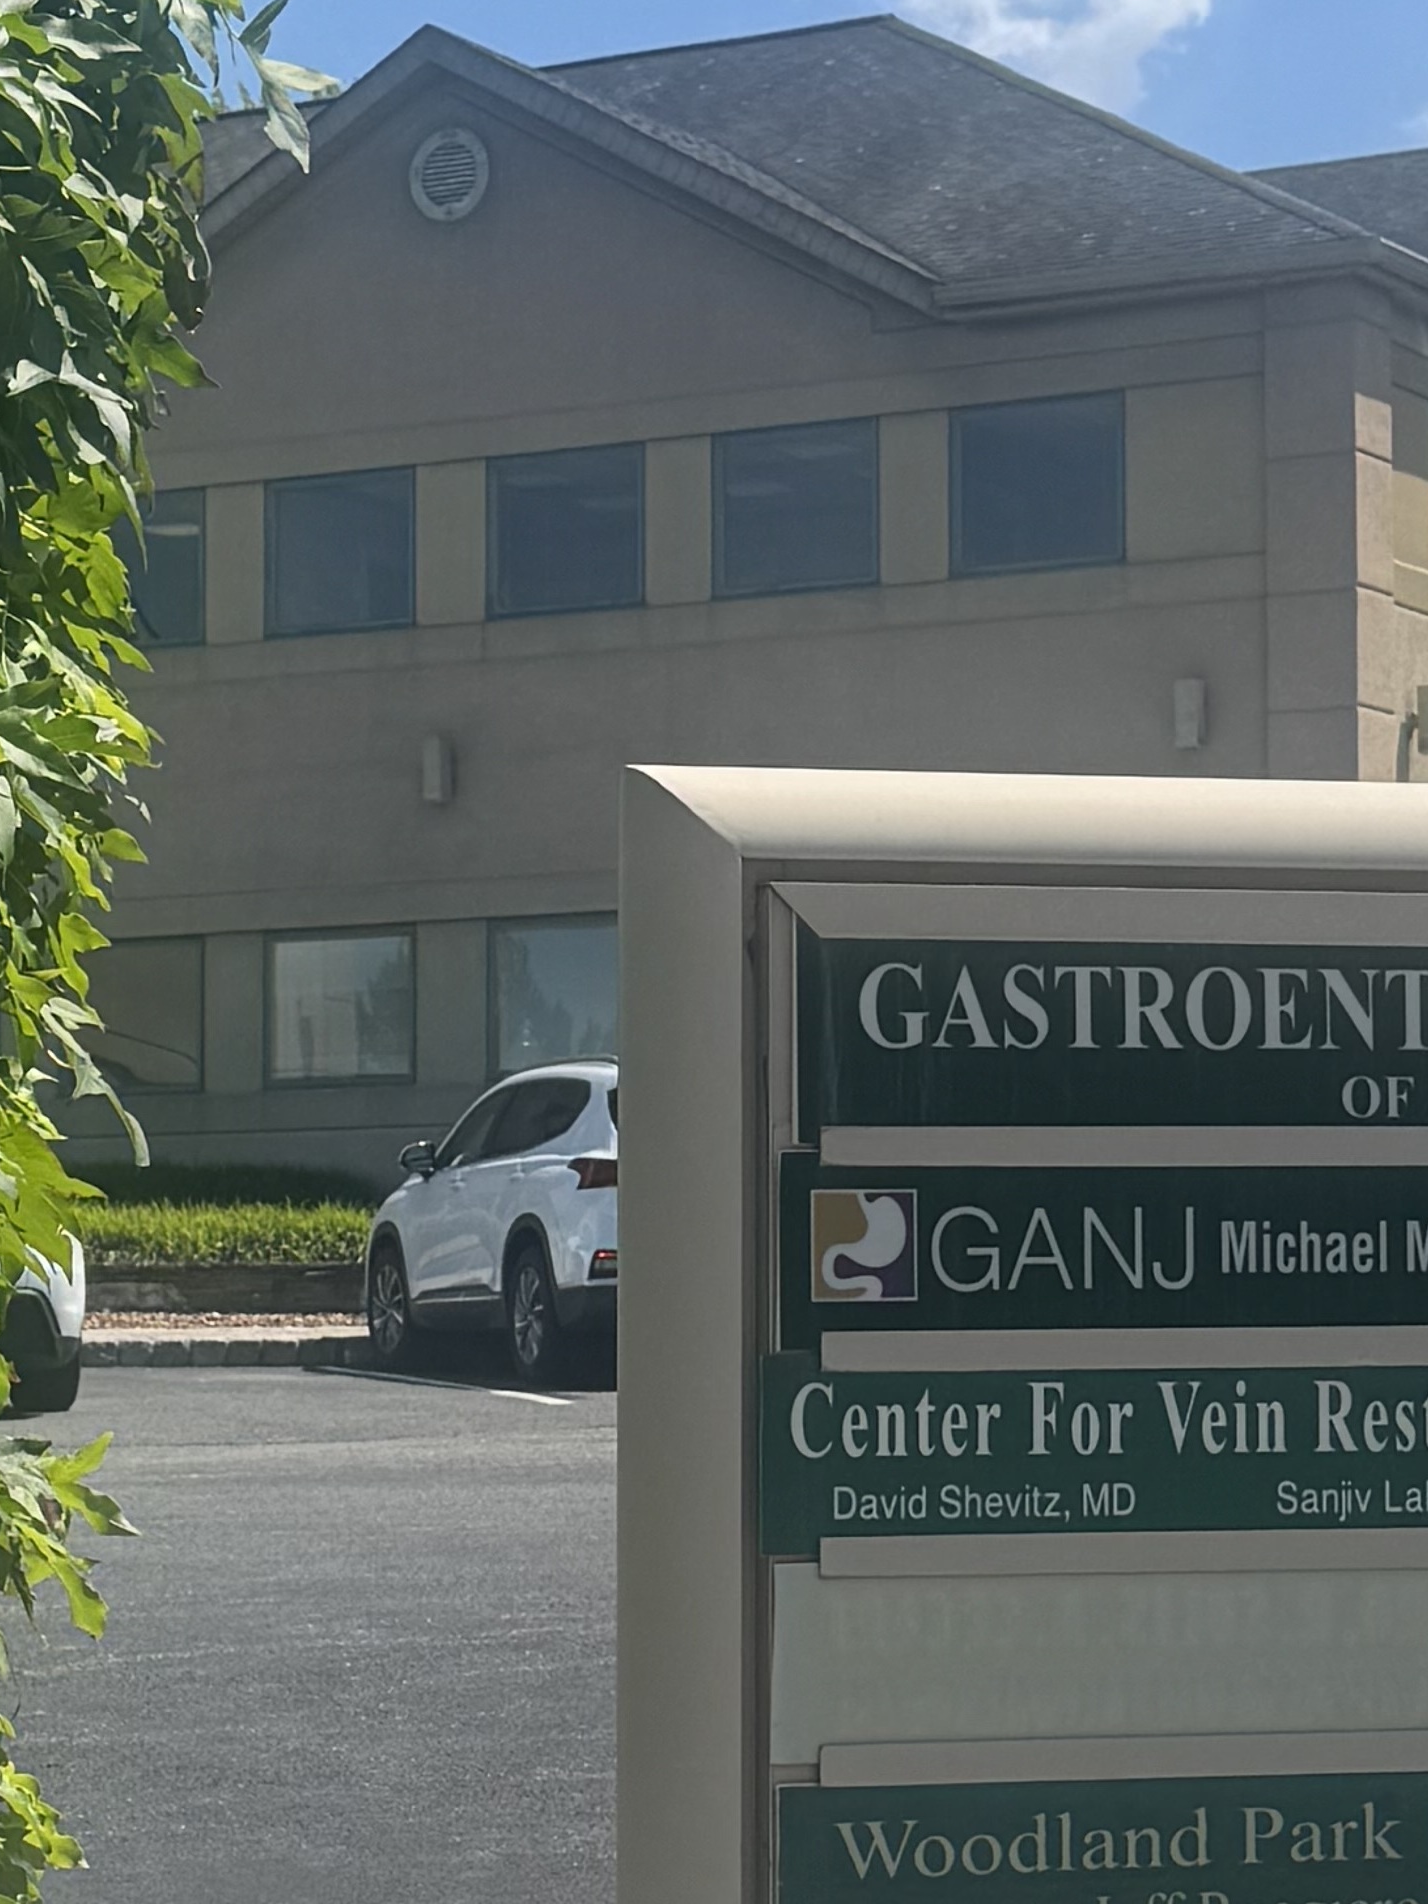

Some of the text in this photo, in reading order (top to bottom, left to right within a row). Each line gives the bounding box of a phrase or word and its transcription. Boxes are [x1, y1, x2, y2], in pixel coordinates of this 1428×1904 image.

[1342, 1076, 1414, 1118] OF
[932, 1206, 1194, 1292] GANJ
[1222, 1220, 1387, 1273] Michael
[791, 1383, 1001, 1458] Center
[1028, 1382, 1133, 1455] For
[1158, 1381, 1286, 1454] Vein
[834, 1483, 1135, 1522] David Shevitz, MD
[1277, 1481, 1371, 1522] Sanjiv
[834, 1807, 1211, 1879] Woodland
[1242, 1802, 1402, 1864] Park
